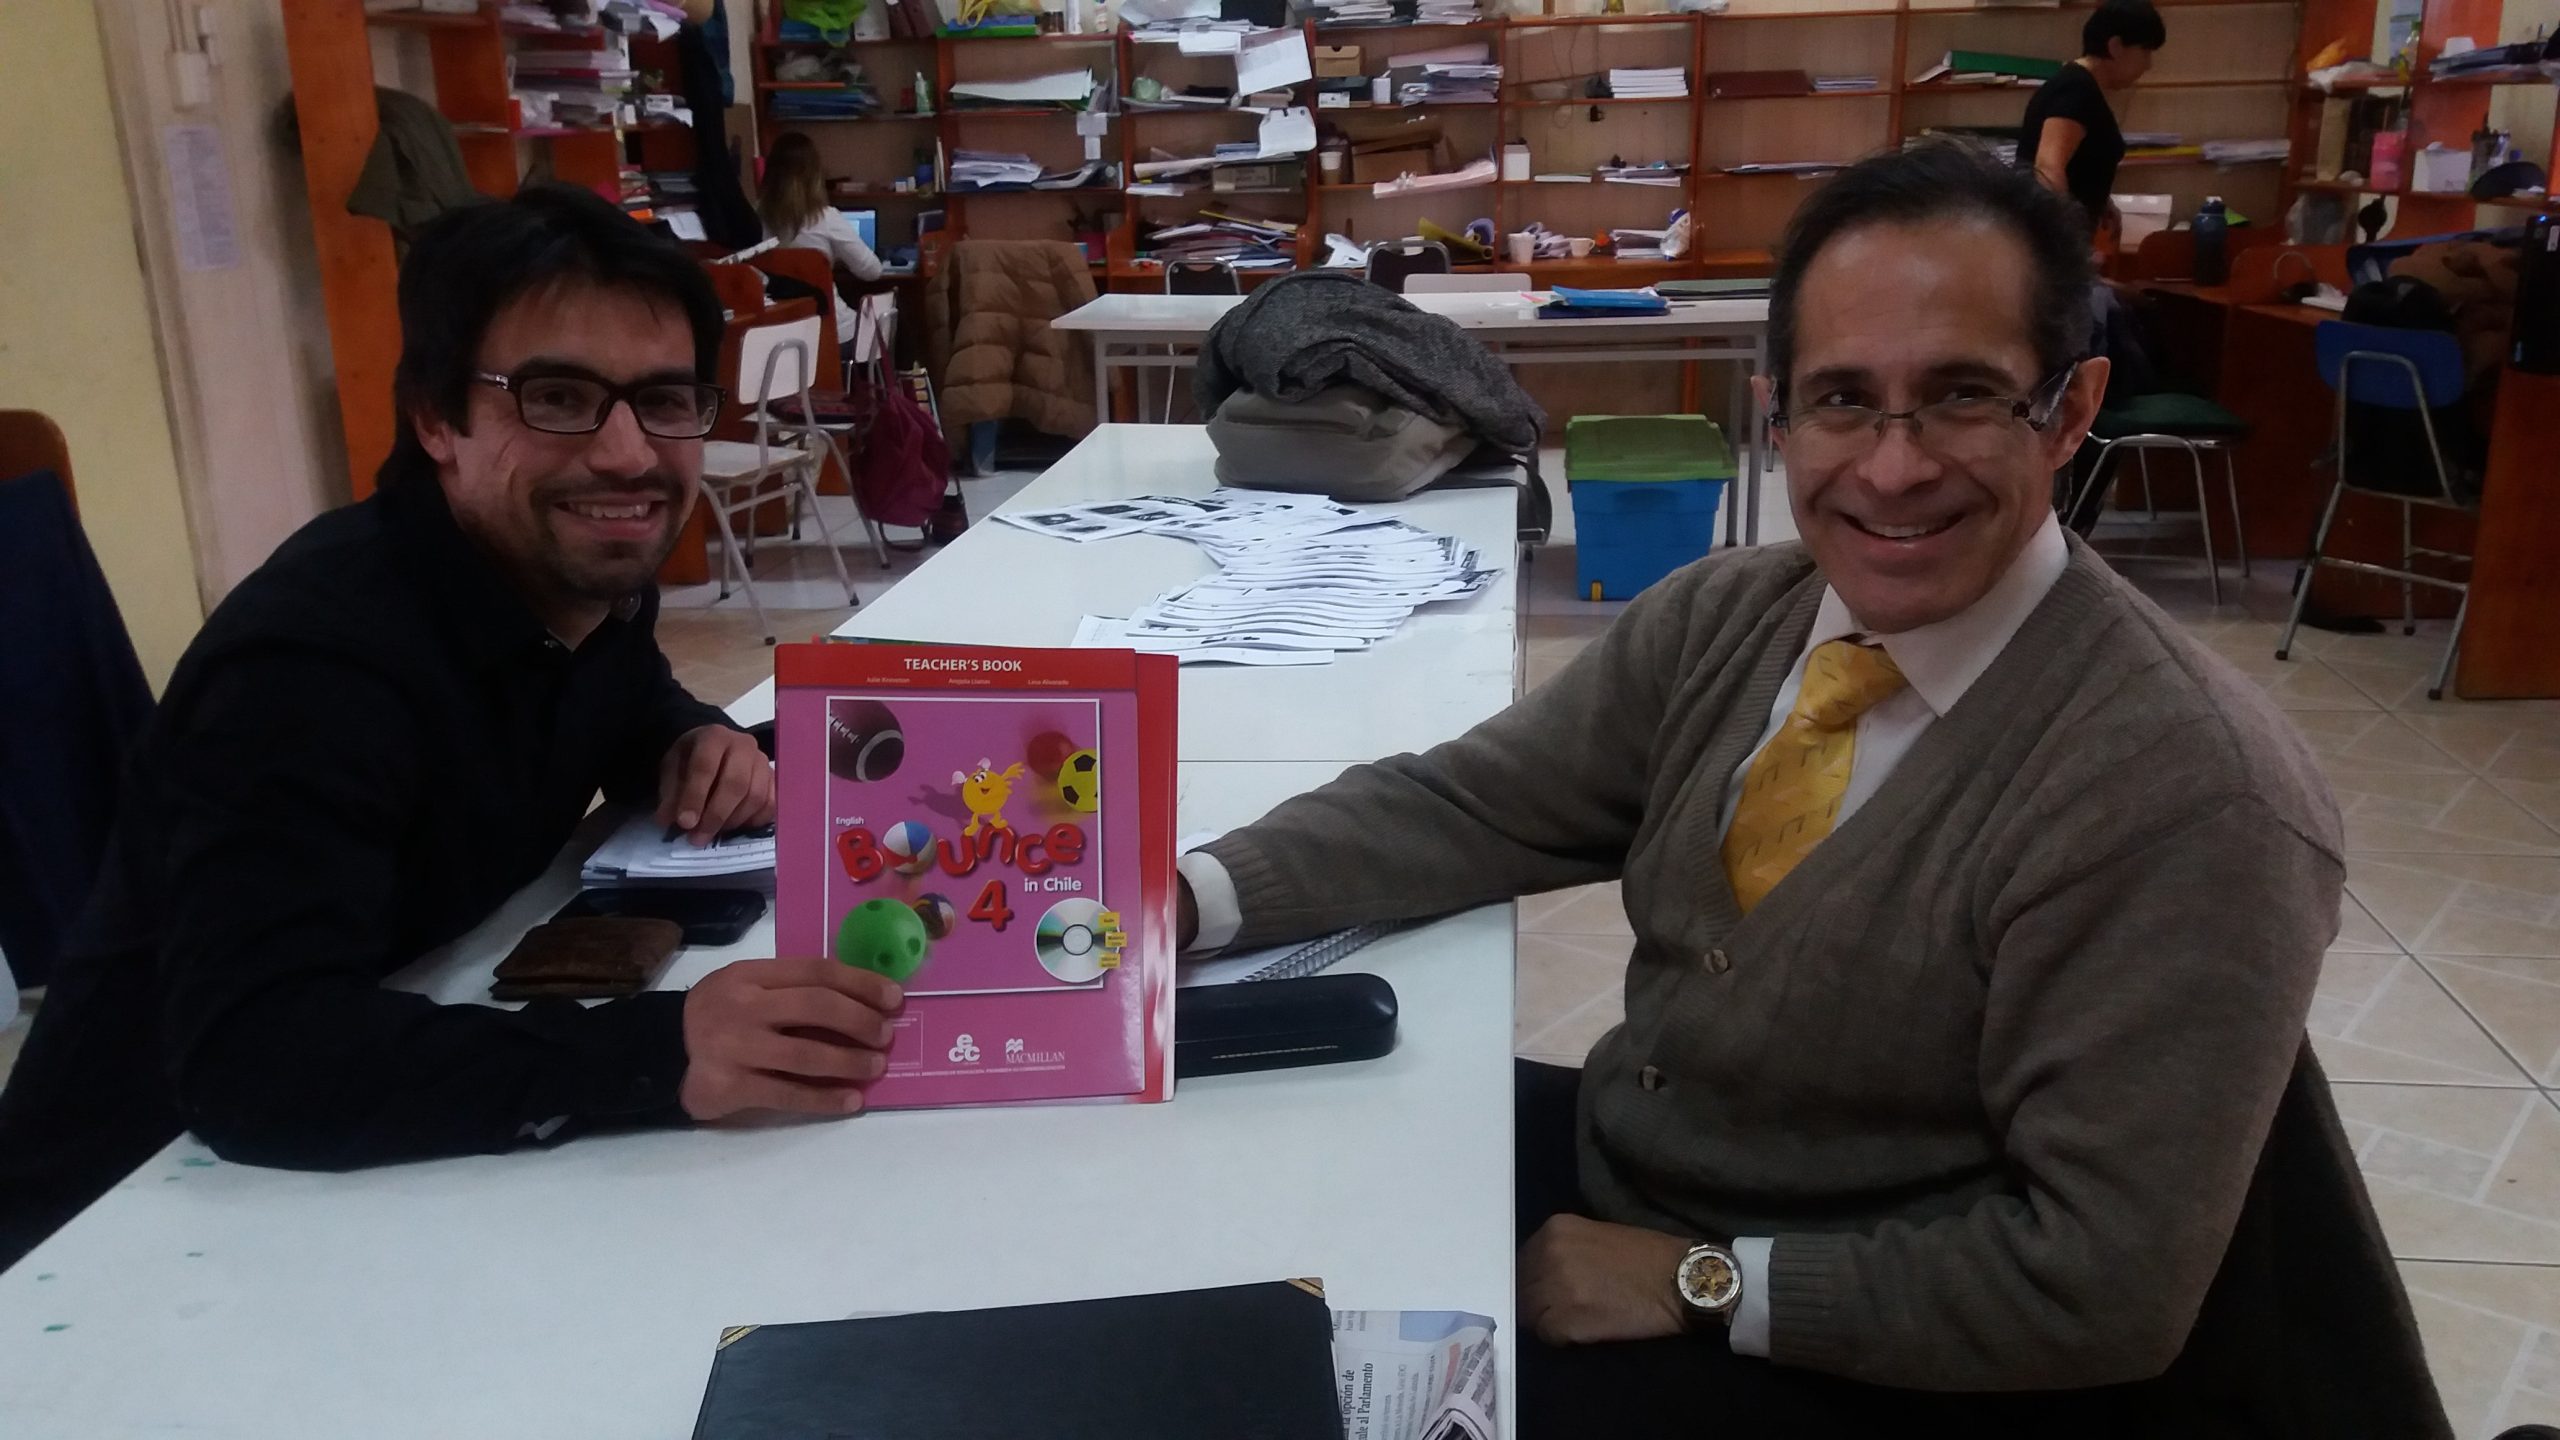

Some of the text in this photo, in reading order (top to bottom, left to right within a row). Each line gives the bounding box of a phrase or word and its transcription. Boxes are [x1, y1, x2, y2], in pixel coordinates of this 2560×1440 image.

[904, 658, 1022, 673] TEACHER'S BOOK
[835, 816, 865, 827] English
[836, 823, 1085, 883] Bounce
[1024, 878, 1082, 892] in Chile
[967, 879, 1013, 932] 4
[1005, 1050, 1066, 1064] MACMILLAN
[1342, 1369, 1355, 1382] de
[1357, 1362, 1374, 1414] Parlamento
